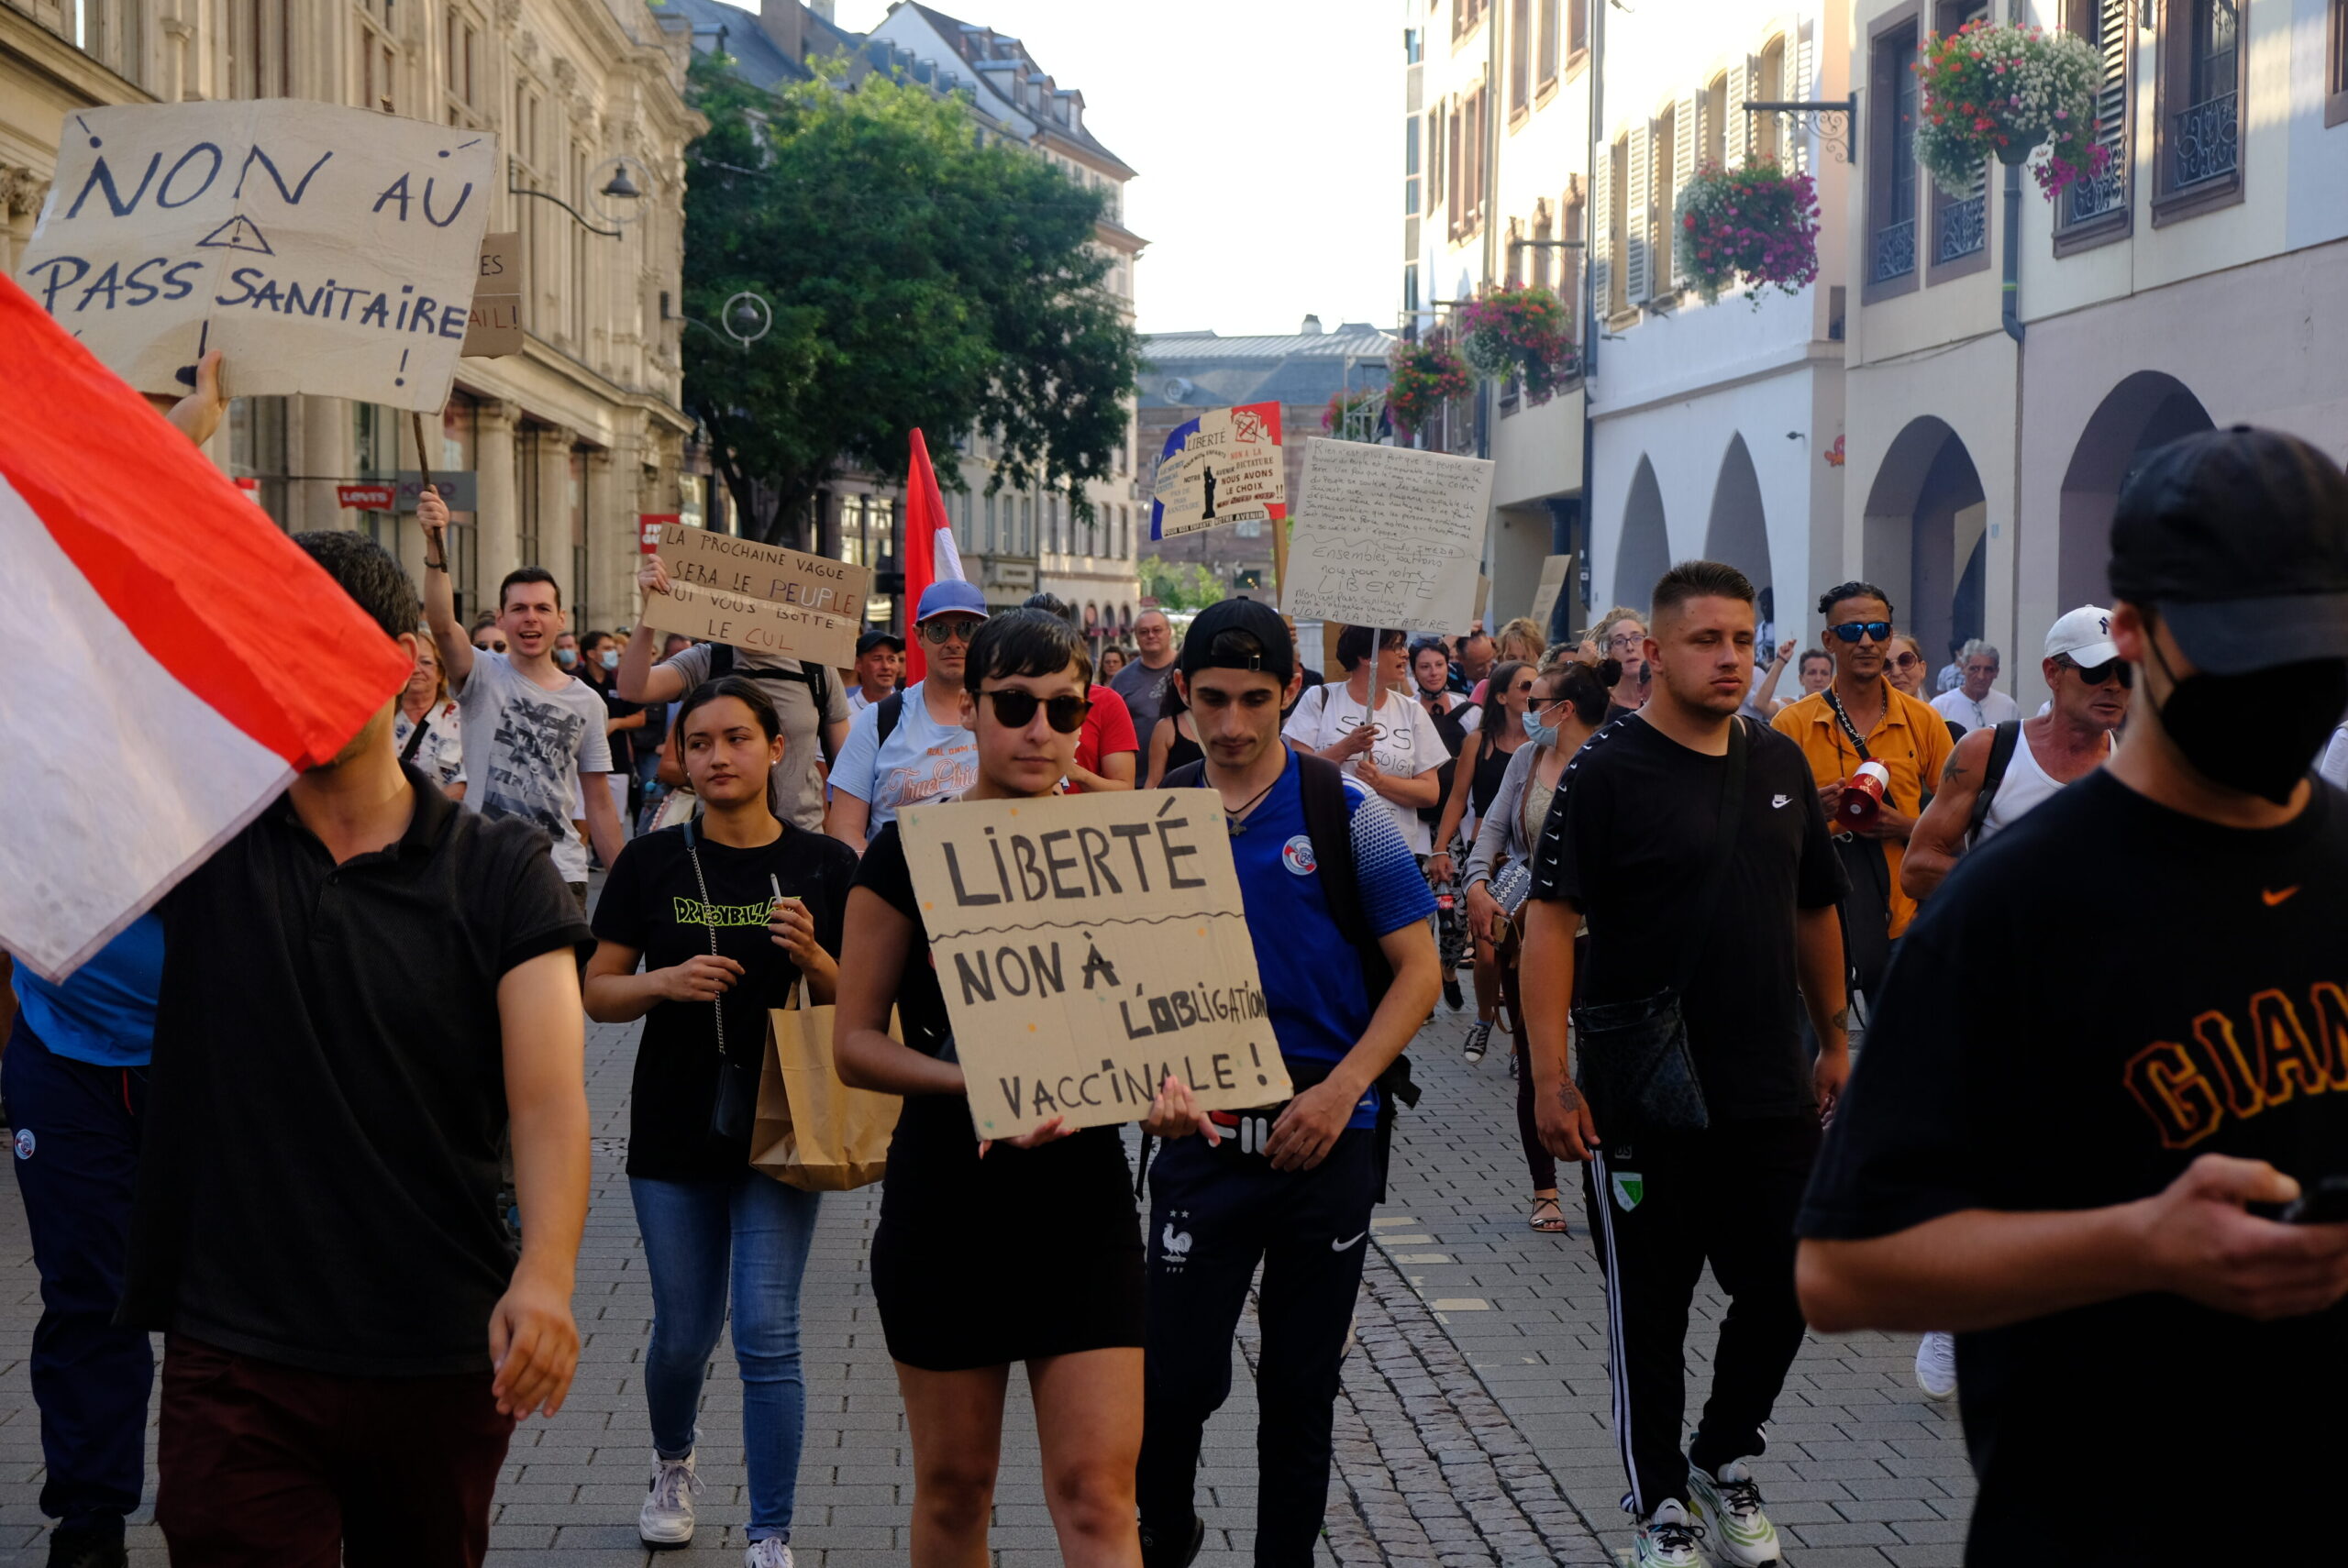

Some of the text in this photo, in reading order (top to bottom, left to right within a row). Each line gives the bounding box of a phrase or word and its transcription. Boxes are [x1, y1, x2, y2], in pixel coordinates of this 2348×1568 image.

[64, 140, 473, 227] NON AU
[27, 256, 469, 339] PASS SANITAIRE
[1188, 427, 1225, 451] LIBERTÉ
[1183, 473, 1201, 483] NOTRE
[1221, 469, 1273, 485] NOUS AVONS
[1236, 457, 1274, 469] DICTATURE
[1225, 481, 1263, 495] LE CHOIX
[1235, 510, 1265, 522] AVENIR
[667, 526, 685, 546] LA
[700, 534, 786, 565] PROCHAINE
[797, 558, 845, 580] VAGUE
[671, 560, 856, 614] SERA LE PEUPLE
[710, 596, 757, 614] VOUS
[777, 608, 836, 629] BOTTE
[1291, 605, 1326, 617] NON
[707, 619, 795, 651] LE CUL
[1335, 715, 1412, 750] SOS
[942, 796, 1206, 906] LIBERTÉ
[954, 931, 1121, 1006] NON À
[1119, 980, 1269, 1040] L'OBLIGATION
[1249, 1043, 1268, 1087] !
